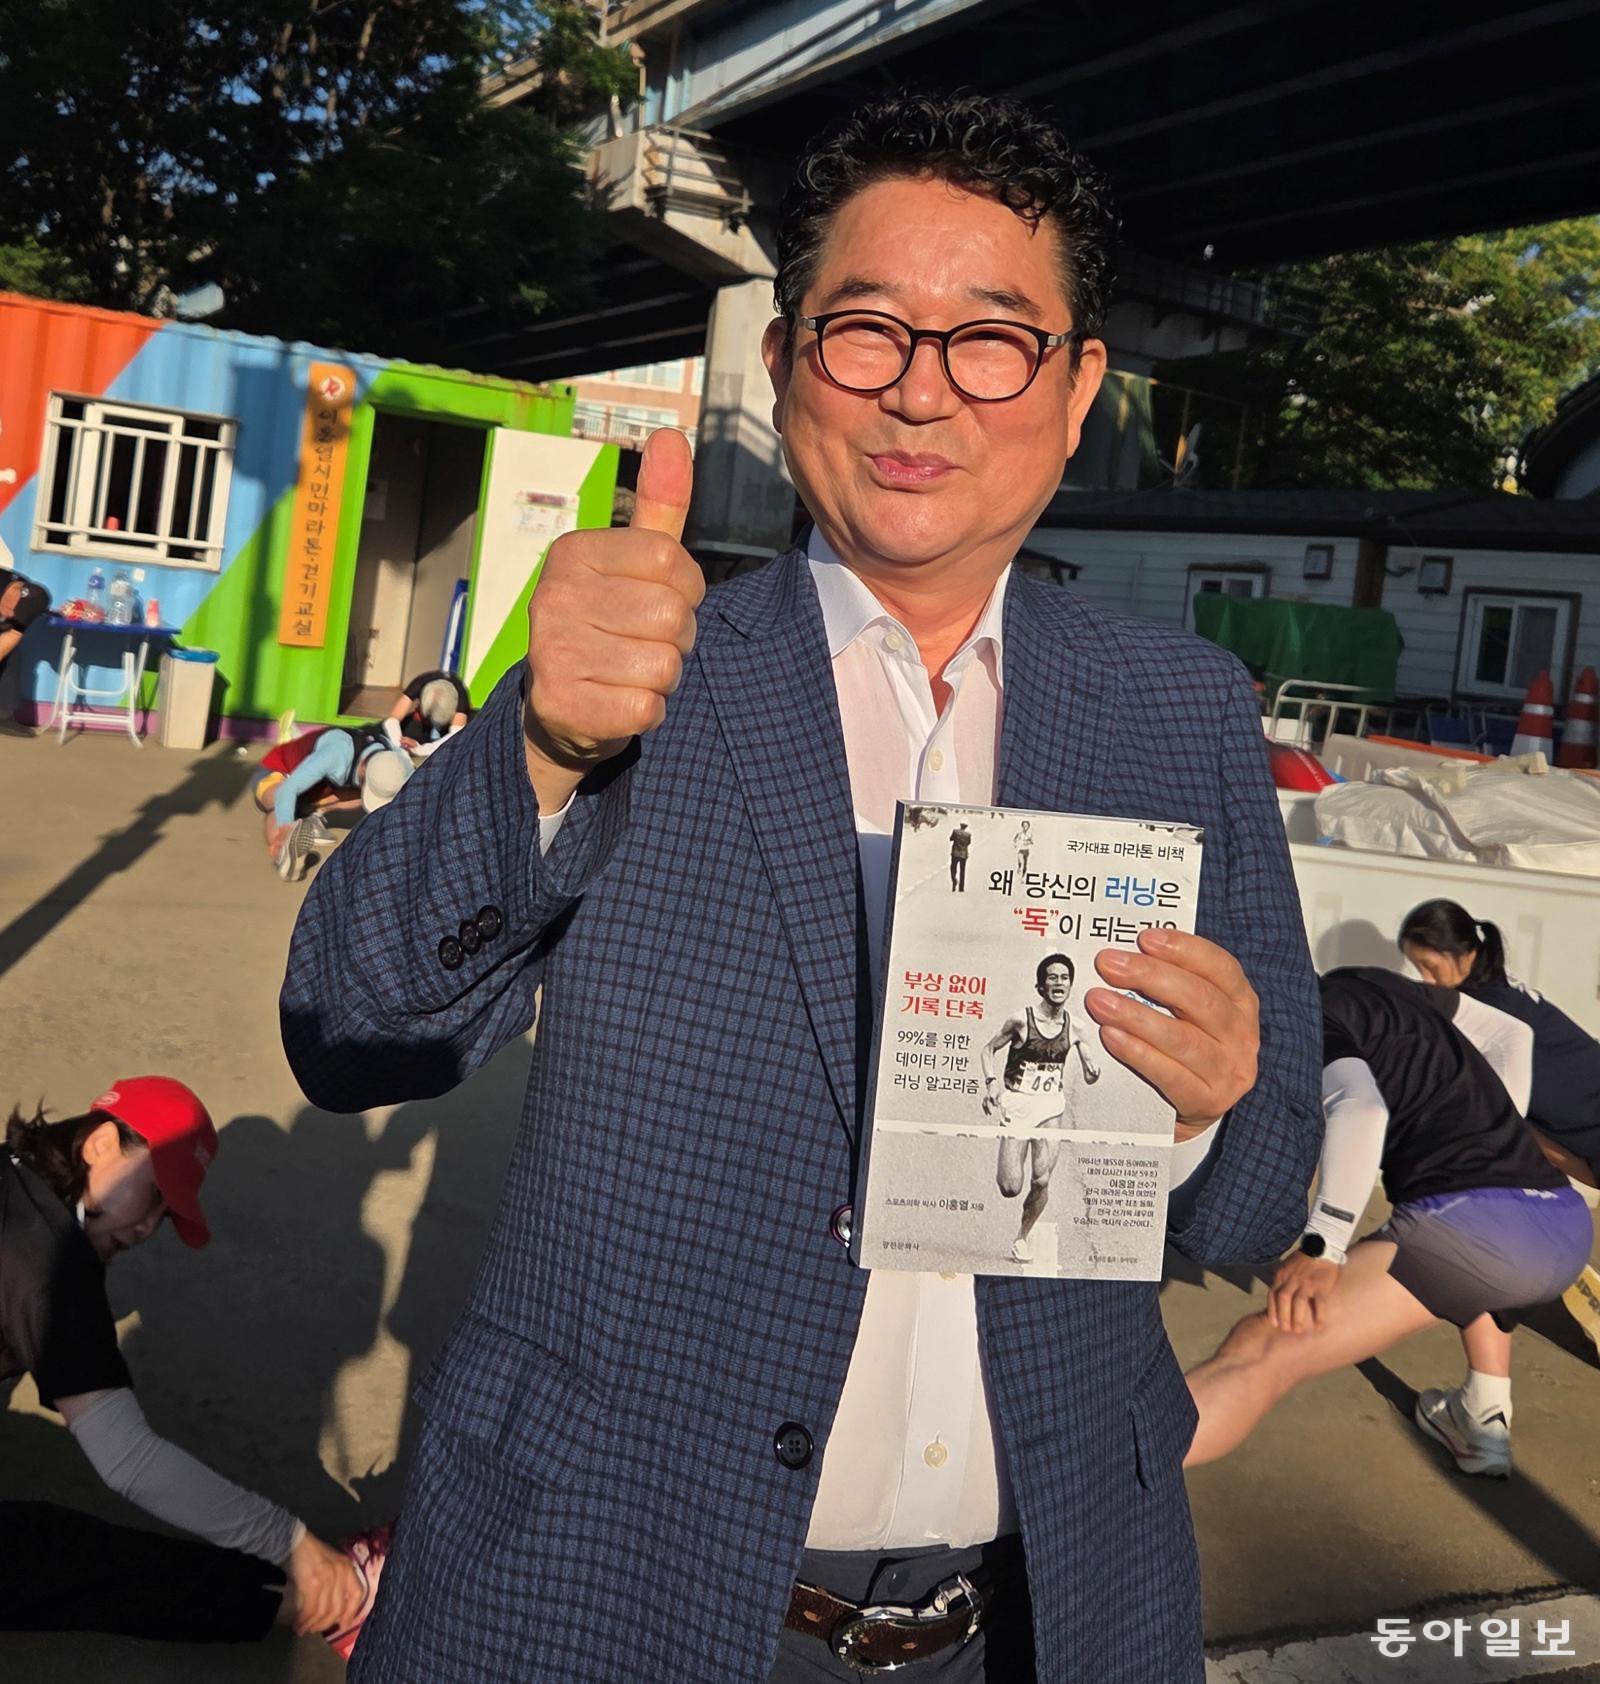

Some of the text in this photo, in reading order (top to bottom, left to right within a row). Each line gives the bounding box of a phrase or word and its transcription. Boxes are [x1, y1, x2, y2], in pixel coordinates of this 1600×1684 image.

[1066, 840, 1184, 861] 국가대표 마라톤 비책
[988, 870, 1181, 908] 왜 당신의 러닝은
[904, 971, 986, 995] 부상 없이
[901, 995, 984, 1020] 기록 단축
[897, 1030, 971, 1050] 99%를 위한
[896, 1052, 969, 1072] 데이터 기반
[894, 1074, 980, 1095] 러닝 알고리즘
[1110, 1179, 1136, 1188] 이홍열
[939, 1198, 969, 1211] 이홍열
